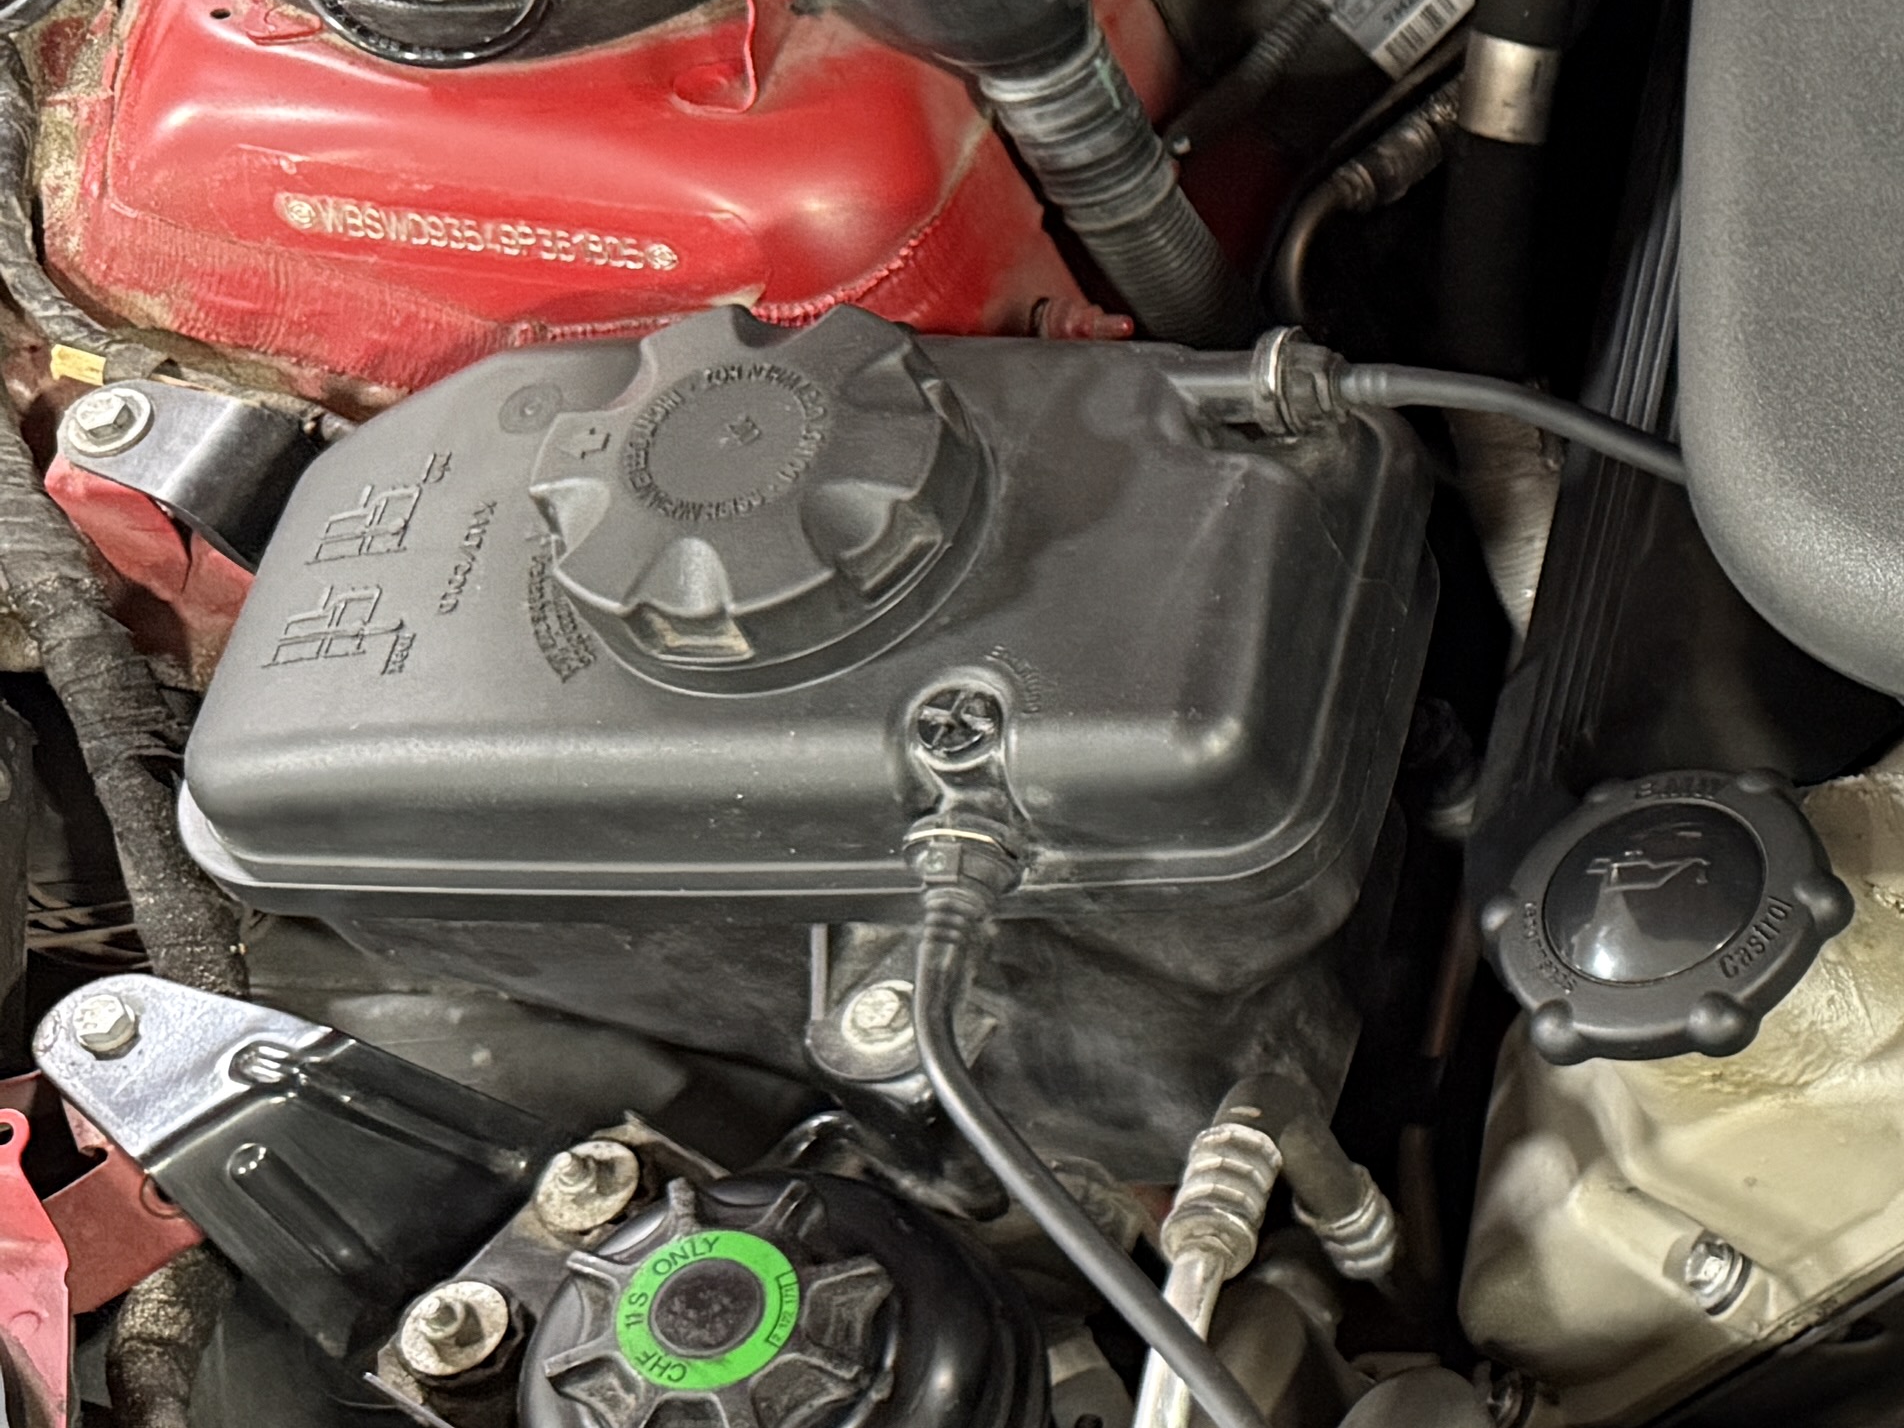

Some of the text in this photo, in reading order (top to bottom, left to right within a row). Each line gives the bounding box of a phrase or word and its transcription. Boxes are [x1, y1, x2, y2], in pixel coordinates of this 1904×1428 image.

[1718, 896, 1794, 979] Castrol
[652, 1236, 720, 1277] ONLY
[636, 1349, 688, 1383] CHF
